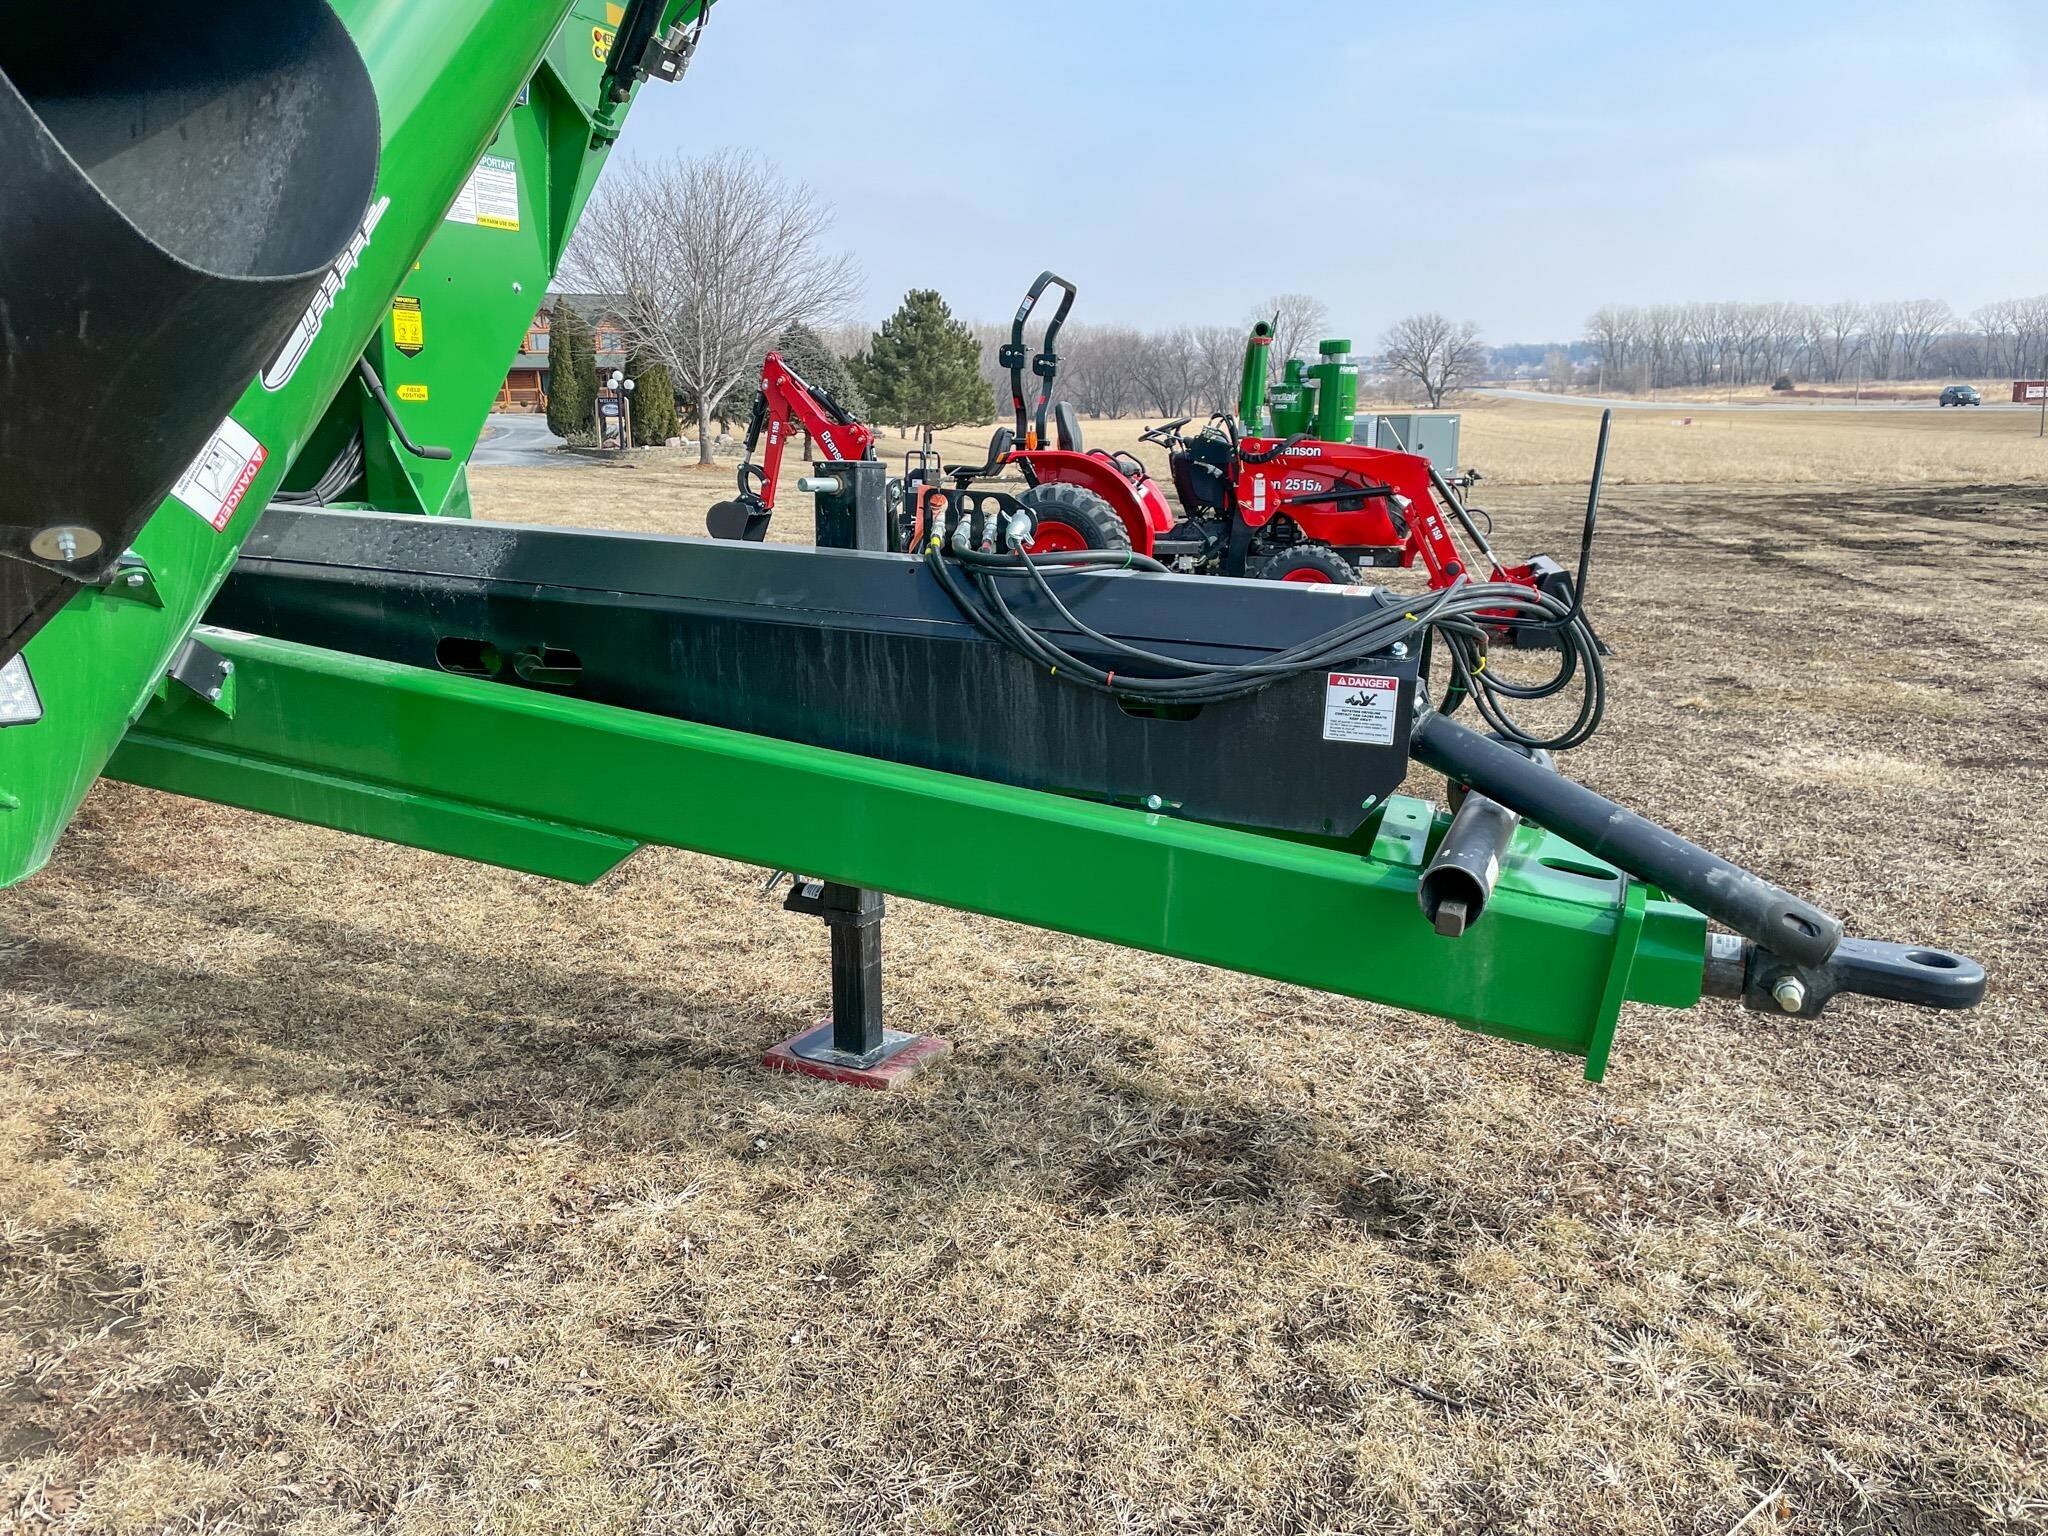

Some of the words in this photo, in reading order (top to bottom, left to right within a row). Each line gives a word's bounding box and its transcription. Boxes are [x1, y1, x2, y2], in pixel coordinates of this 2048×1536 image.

[480, 156, 515, 171] PORTANT
[772, 421, 780, 433] 150
[770, 434, 777, 445] BH
[1285, 479, 1322, 491] 2515h
[214, 463, 257, 528] DANGER
[1426, 515, 1437, 527] BL
[1432, 526, 1443, 540] 150
[1348, 677, 1390, 689] DANGER
